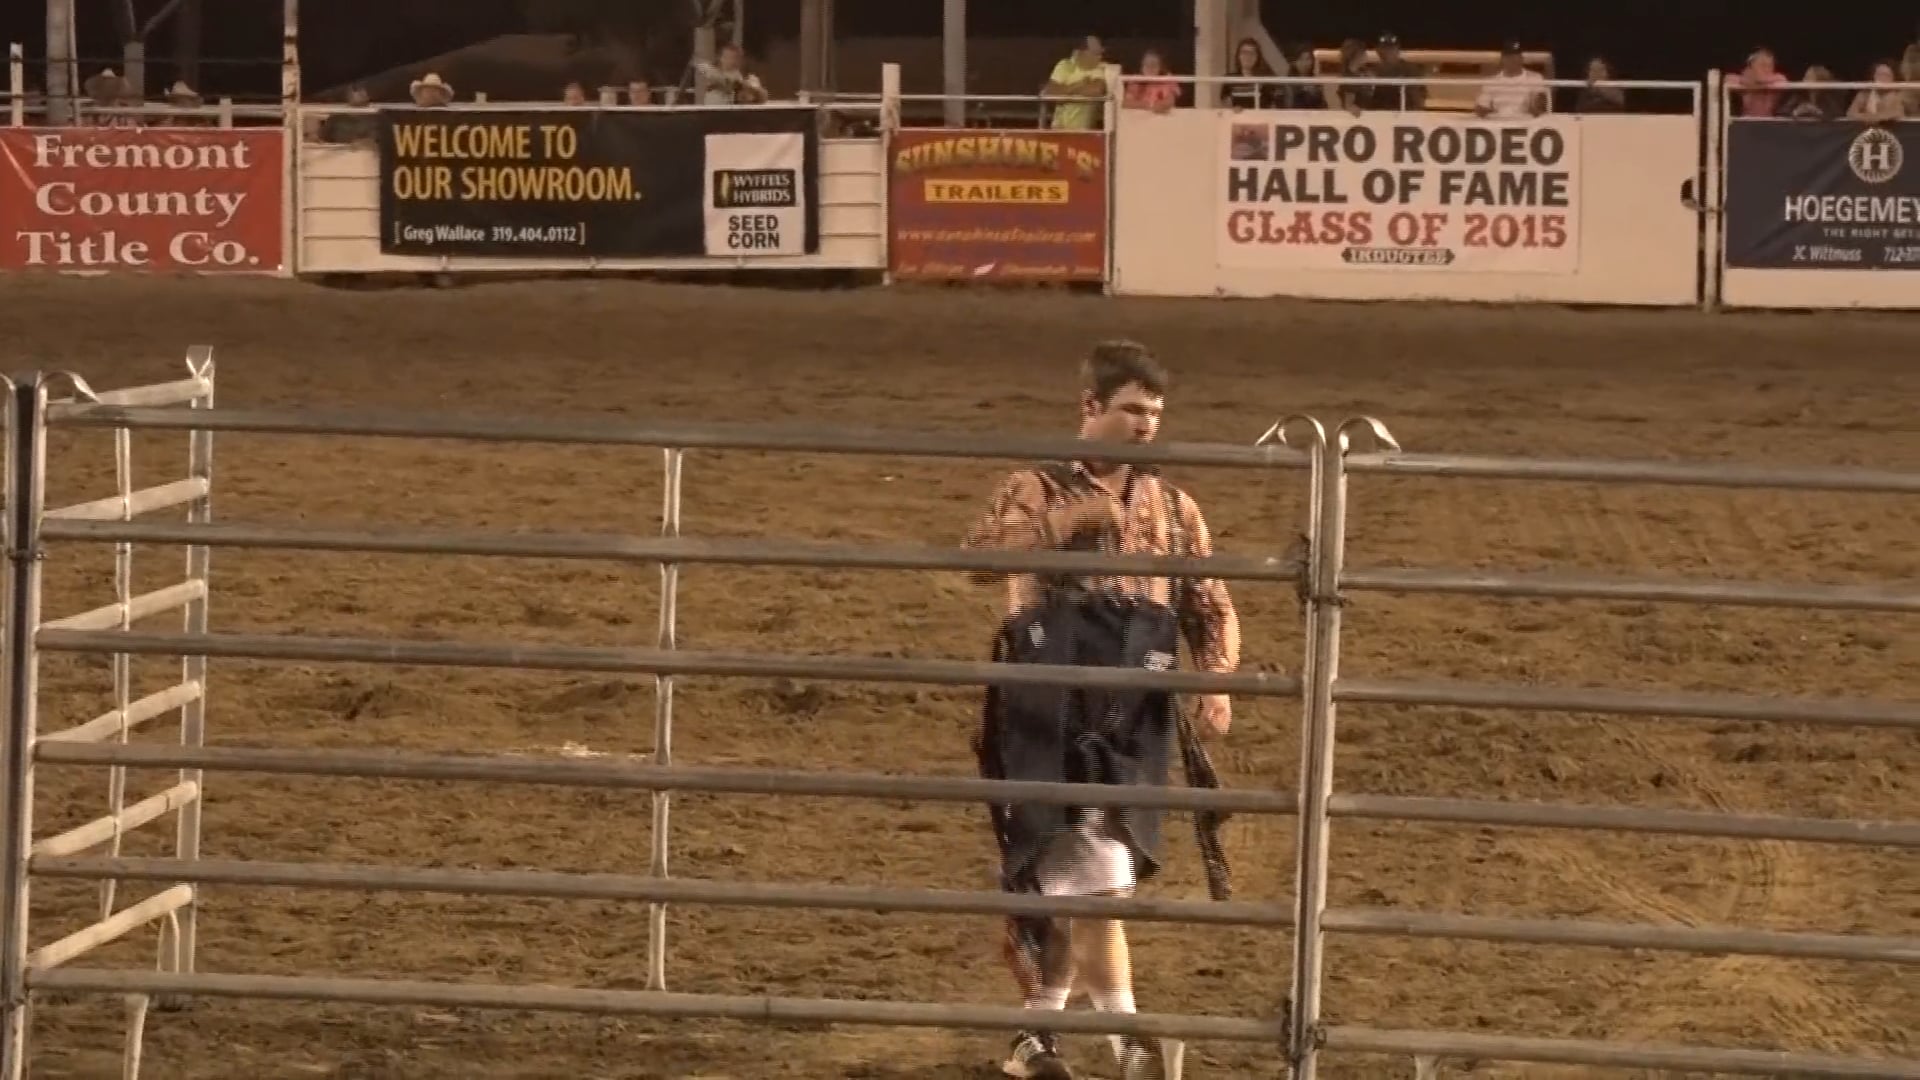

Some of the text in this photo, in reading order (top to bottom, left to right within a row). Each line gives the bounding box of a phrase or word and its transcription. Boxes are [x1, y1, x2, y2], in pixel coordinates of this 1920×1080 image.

[33, 134, 252, 169] Fremont
[393, 124, 577, 158] WELCOME TO
[1274, 124, 1564, 166] PRO RODEO
[393, 166, 642, 200] OUR SHOWROOM.
[733, 189, 791, 203] HYBRIDS
[931, 184, 1062, 200] TRAILERS
[1228, 167, 1569, 207] HALL OF FAME
[36, 181, 247, 227] County
[436, 225, 485, 241] Wallace
[728, 214, 779, 231] SEED
[1227, 210, 1568, 248] CLASS OF 2015
[16, 231, 260, 265] Title Co.
[728, 232, 780, 249] CORN
